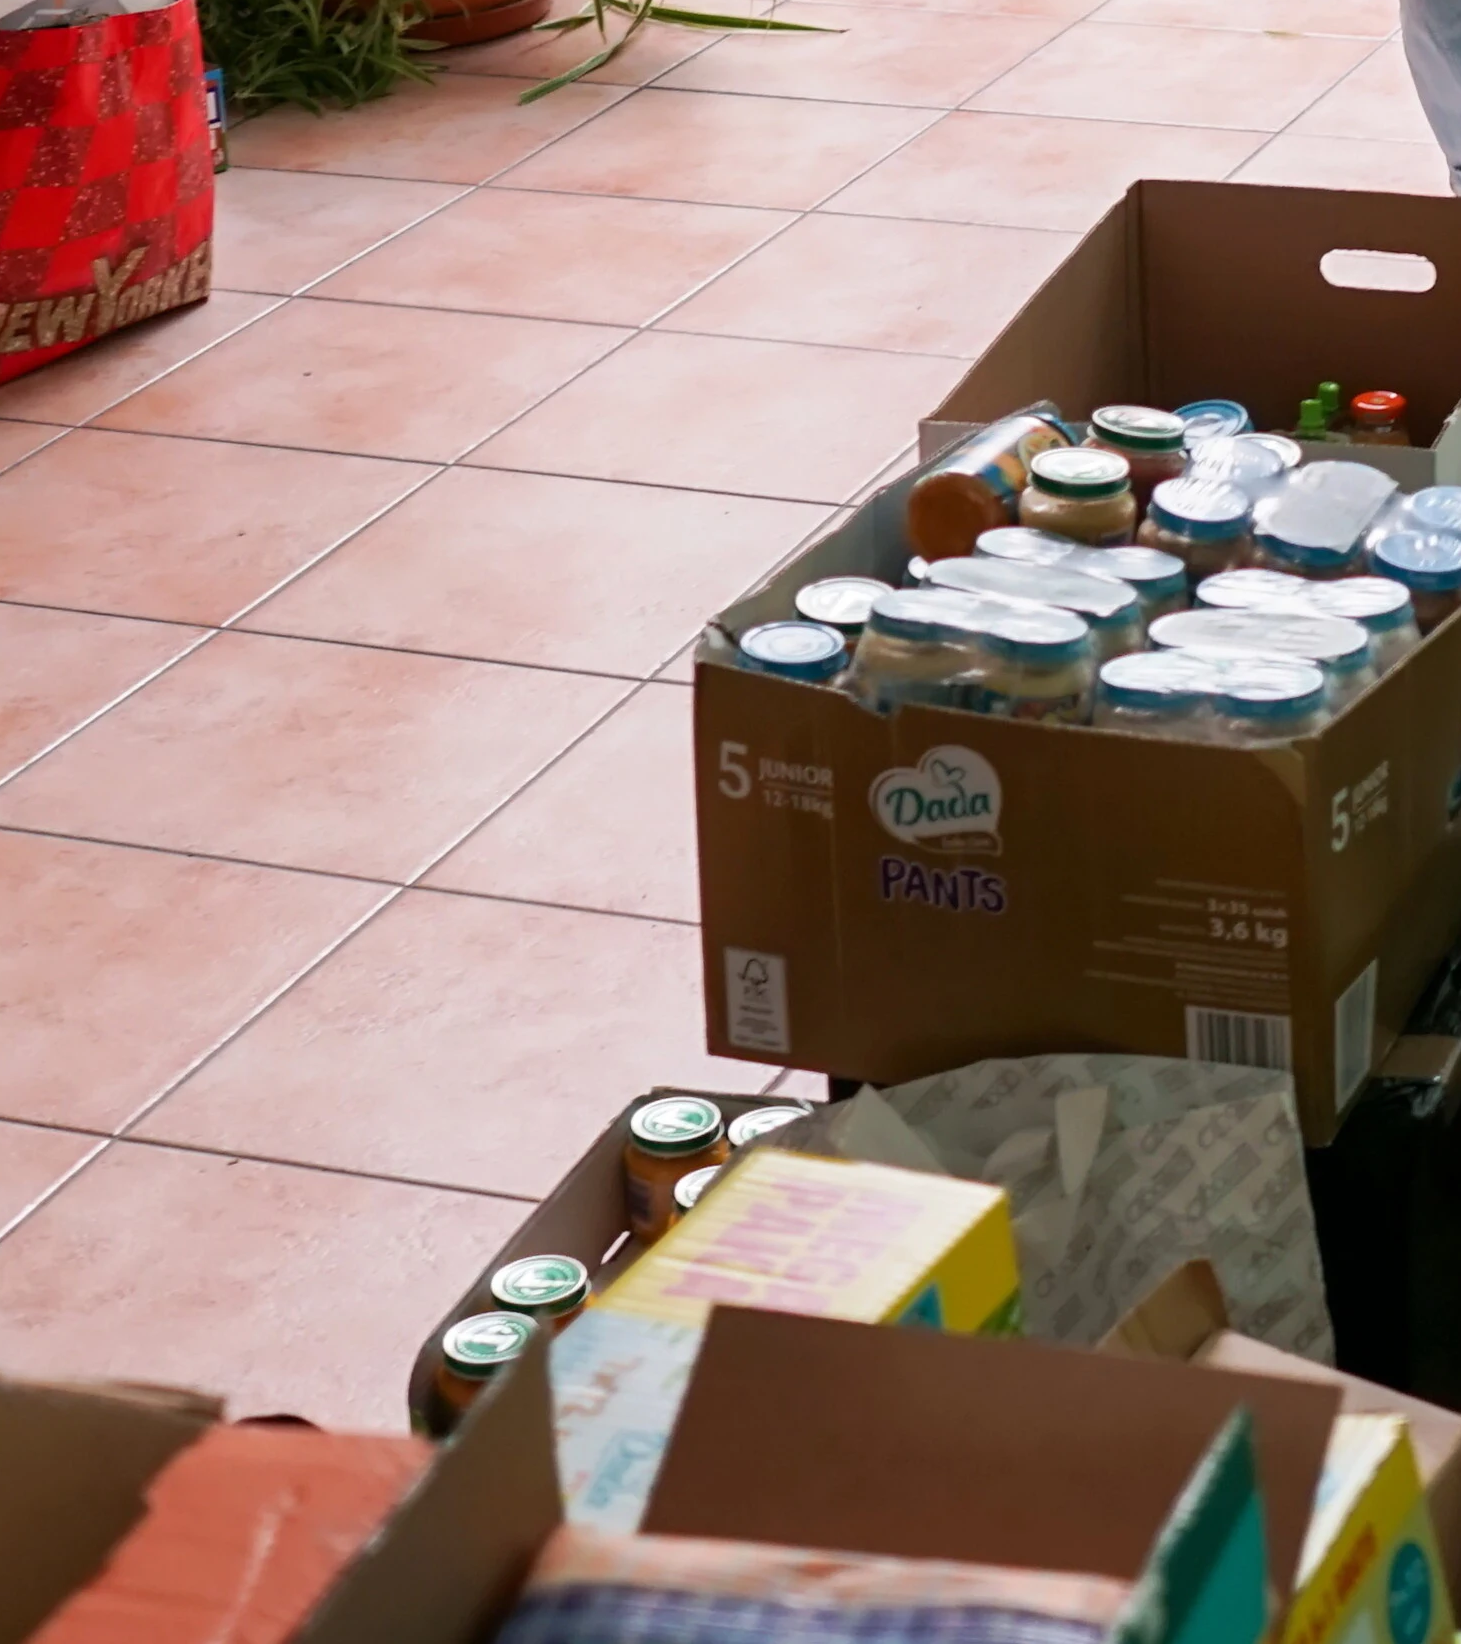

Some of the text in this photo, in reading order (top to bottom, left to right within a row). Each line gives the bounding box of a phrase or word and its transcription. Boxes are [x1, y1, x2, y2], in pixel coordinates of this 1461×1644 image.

[718, 739, 834, 799] 5 JUNIOR
[884, 786, 993, 826] Dada
[880, 856, 1007, 914] PANTS
[1208, 917, 1251, 941] 3,6
[1254, 921, 1288, 949] kg
